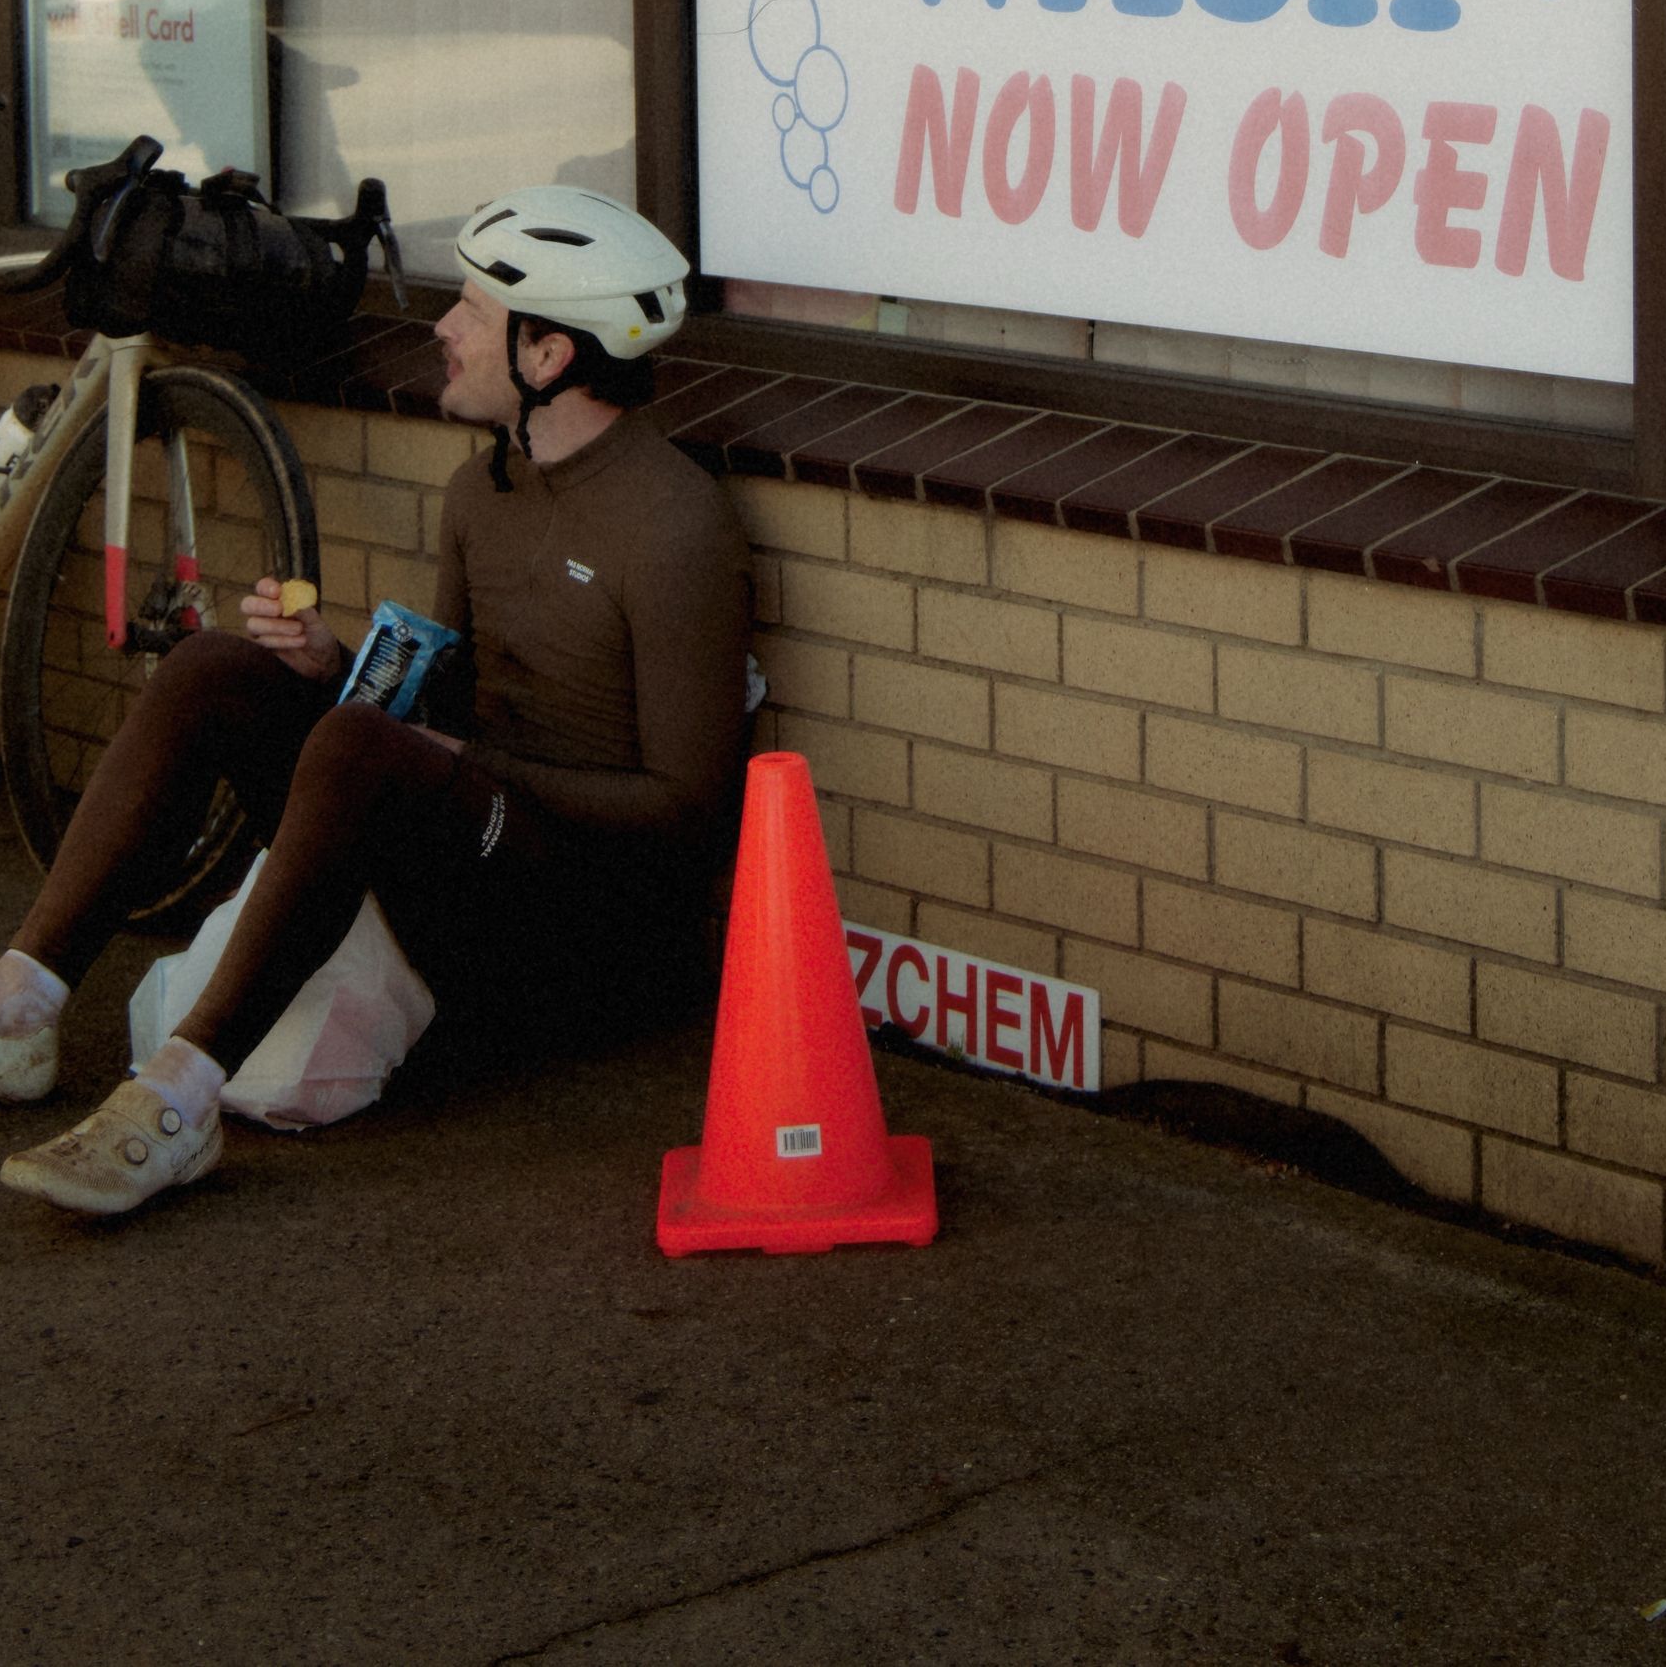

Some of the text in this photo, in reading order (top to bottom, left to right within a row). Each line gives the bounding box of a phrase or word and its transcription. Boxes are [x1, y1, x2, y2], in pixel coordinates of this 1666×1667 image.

[145, 8, 195, 43] Card
[893, 63, 1612, 283] NOW OPEN
[575, 561, 595, 578] NORMAL
[480, 811, 506, 858] NORMAL
